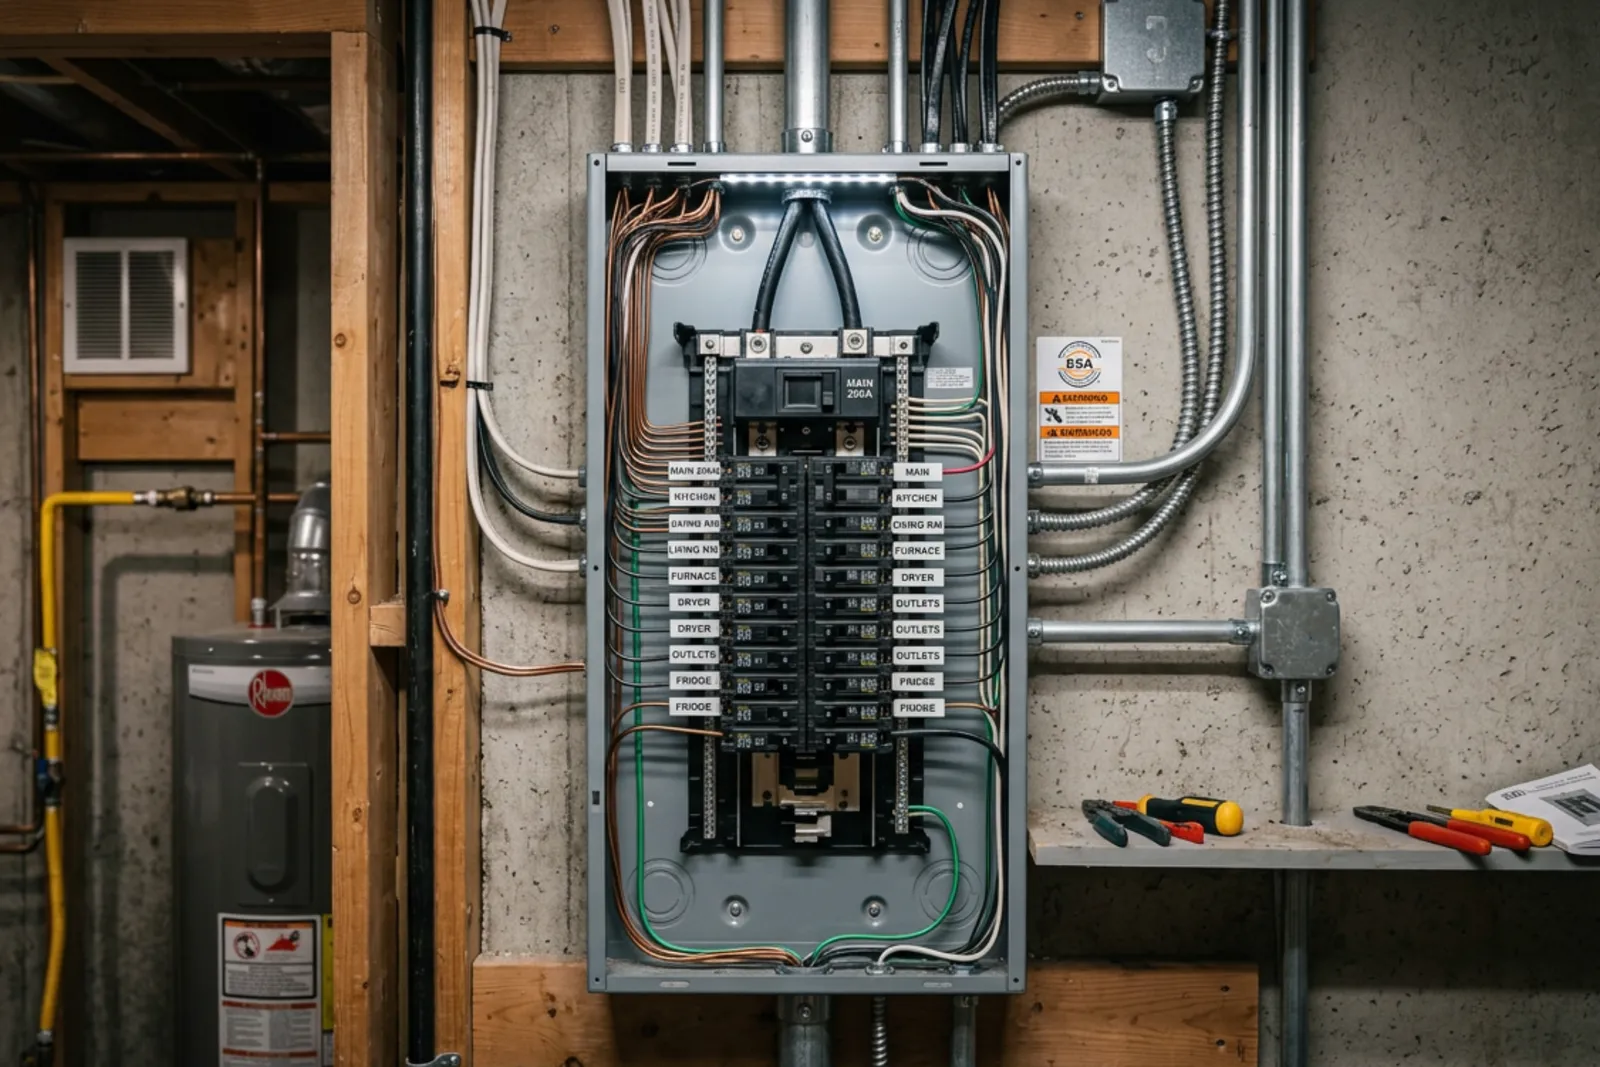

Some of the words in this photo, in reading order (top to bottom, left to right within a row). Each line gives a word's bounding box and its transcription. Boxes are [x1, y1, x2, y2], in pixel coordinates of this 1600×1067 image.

[1066, 358, 1093, 369] BSA
[846, 379, 874, 388] MAIN
[670, 467, 694, 475] MAIN
[905, 468, 930, 476] MAIN
[671, 572, 717, 580] FURNACE
[901, 573, 935, 582] DRYER
[896, 599, 940, 608] OUTLETS
[677, 624, 712, 633] DRYER
[896, 651, 941, 660] OUTLETS
